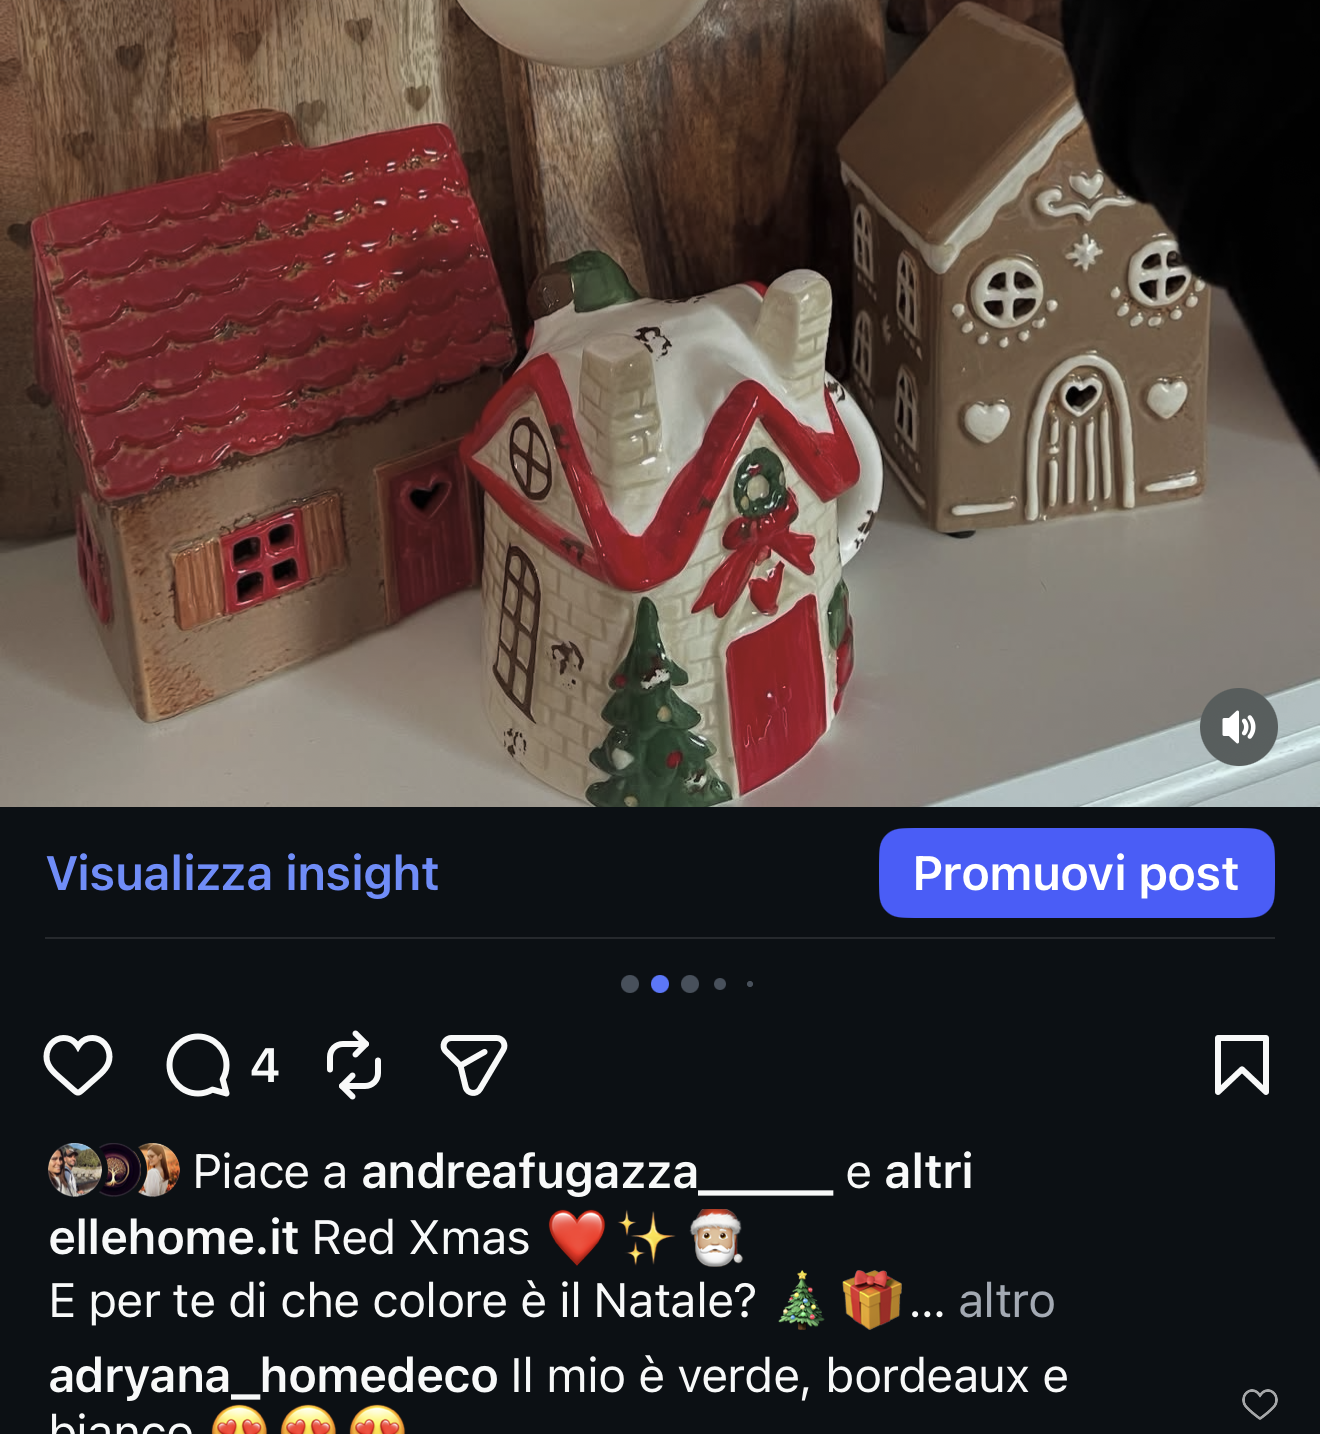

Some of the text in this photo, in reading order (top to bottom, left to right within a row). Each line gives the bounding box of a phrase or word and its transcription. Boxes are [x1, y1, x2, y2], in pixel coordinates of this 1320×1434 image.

[46, 852, 439, 900] Visualizza insight
[915, 852, 1239, 900] Promuovi post
[250, 1047, 280, 1083] 4
[195, 1151, 309, 1190] Piace
[323, 1161, 346, 1190] a
[846, 1161, 871, 1190] e
[885, 1150, 972, 1190] altri
[49, 1216, 530, 1256] ellehome.it Red Xmas
[51, 1282, 75, 1318] E
[91, 1290, 161, 1327] per
[172, 1284, 215, 1319] te
[229, 1280, 266, 1319] di
[281, 1280, 359, 1319] che
[373, 1280, 507, 1319] colore
[521, 1279, 546, 1319] è
[561, 1280, 579, 1318] il
[596, 1280, 756, 1319] Natale?
[959, 1281, 1055, 1319] altro
[49, 1354, 1068, 1402] adryana_homedeco Il mio è verde, bordeaux e
